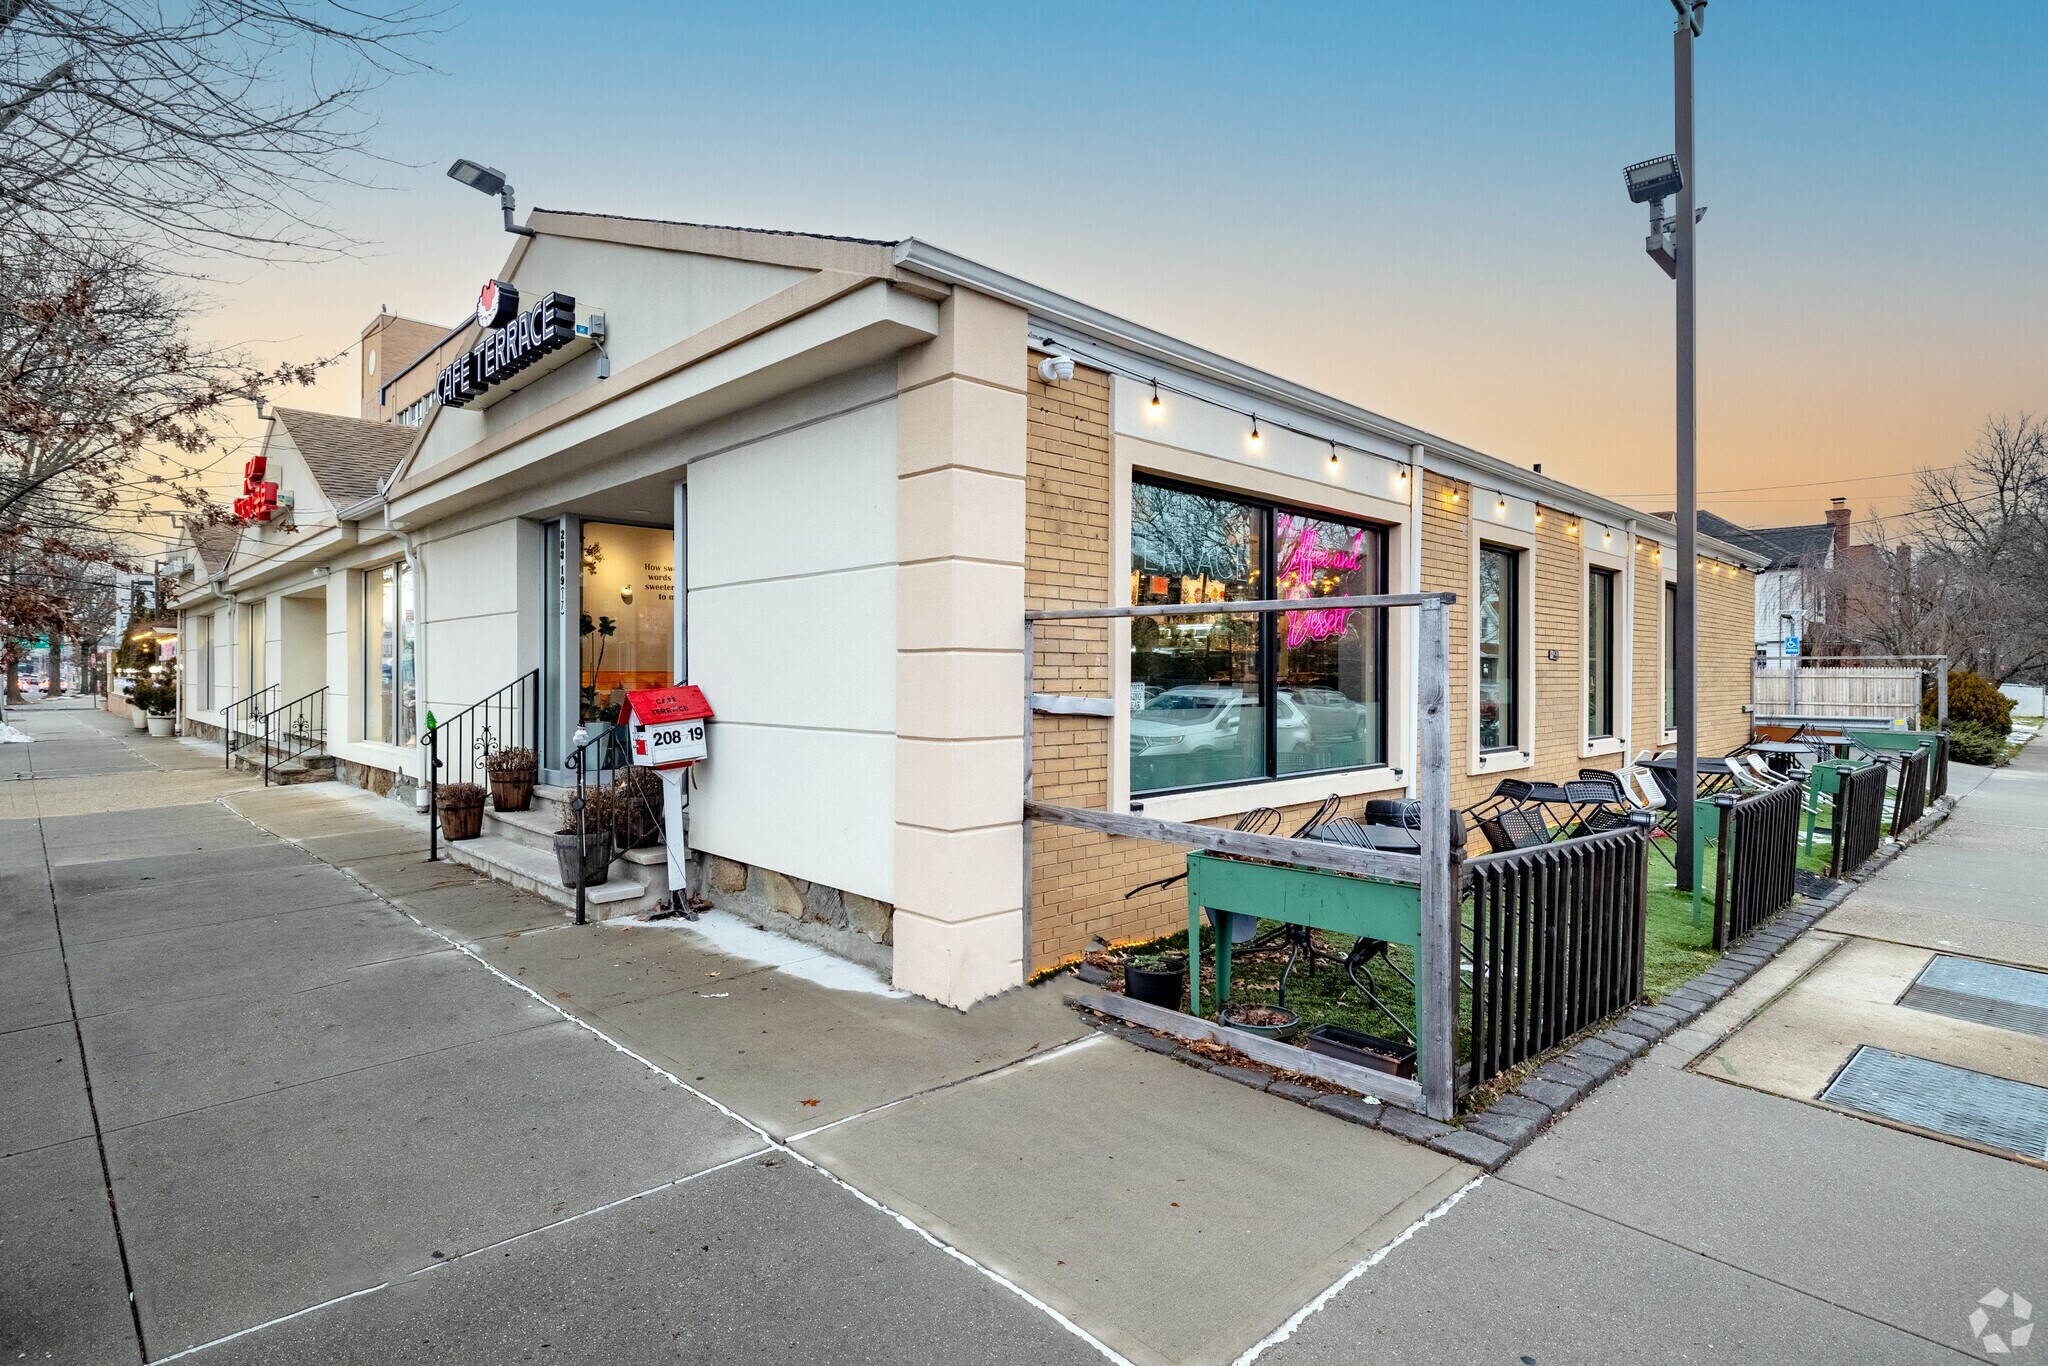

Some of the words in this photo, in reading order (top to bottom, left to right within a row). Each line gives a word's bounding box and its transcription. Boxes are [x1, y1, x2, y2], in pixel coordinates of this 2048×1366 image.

[436, 351, 472, 406] CAFE
[473, 291, 558, 384] TERRACE
[1333, 531, 1362, 571] and
[644, 563, 661, 571] How
[658, 593, 667, 601] to
[651, 705, 689, 715] TERRACE
[652, 730, 682, 747] 208
[687, 726, 704, 742] 19
